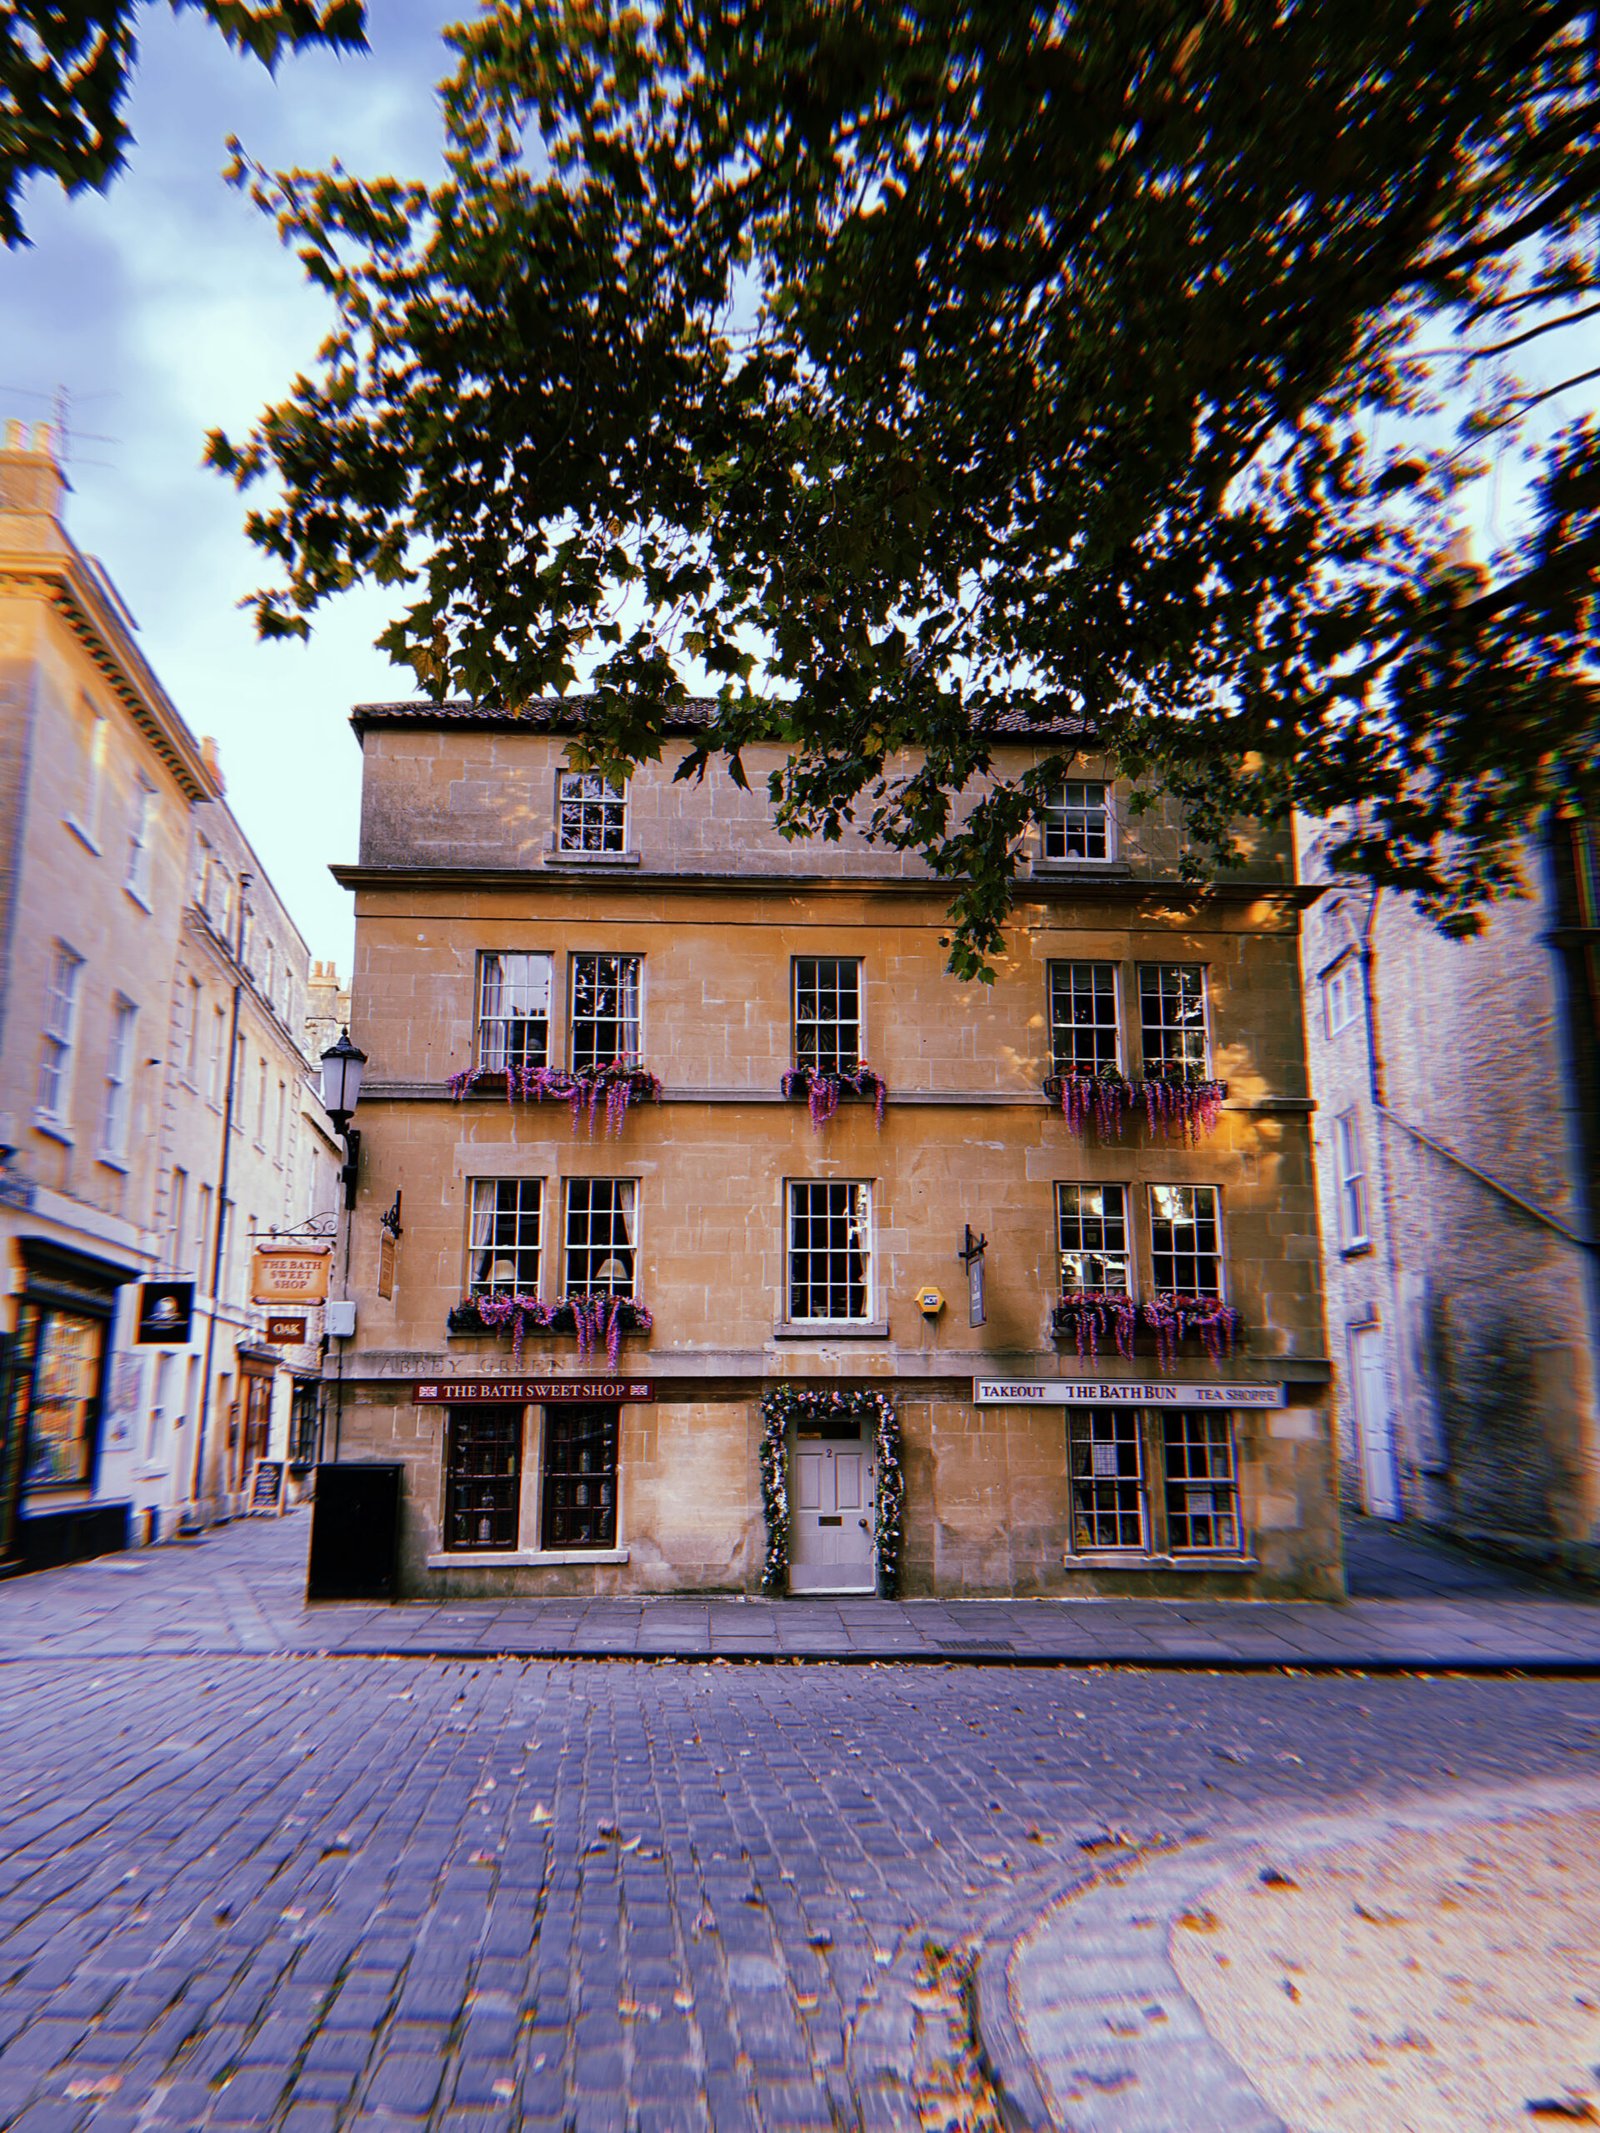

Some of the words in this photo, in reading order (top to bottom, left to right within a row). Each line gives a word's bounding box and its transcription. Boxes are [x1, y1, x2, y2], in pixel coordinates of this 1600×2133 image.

[262, 1260, 288, 1269] THE
[289, 1261, 322, 1270] BATH
[270, 1270, 313, 1279] SWEET
[274, 1280, 308, 1289] SHOP
[923, 1295, 938, 1305] ADT
[272, 1323, 301, 1336] OAK
[378, 1358, 464, 1374] ABBEY
[442, 1385, 477, 1397] THE
[480, 1385, 523, 1397] BATH
[526, 1385, 582, 1396] SWEET
[583, 1384, 625, 1396] SHOP
[981, 1386, 1046, 1397] TAKEOUT
[1065, 1385, 1097, 1398] THE
[1099, 1385, 1141, 1399] BATH
[1144, 1385, 1178, 1400] BUN
[1196, 1389, 1225, 1401] TEA
[826, 1449, 833, 1458] 2
